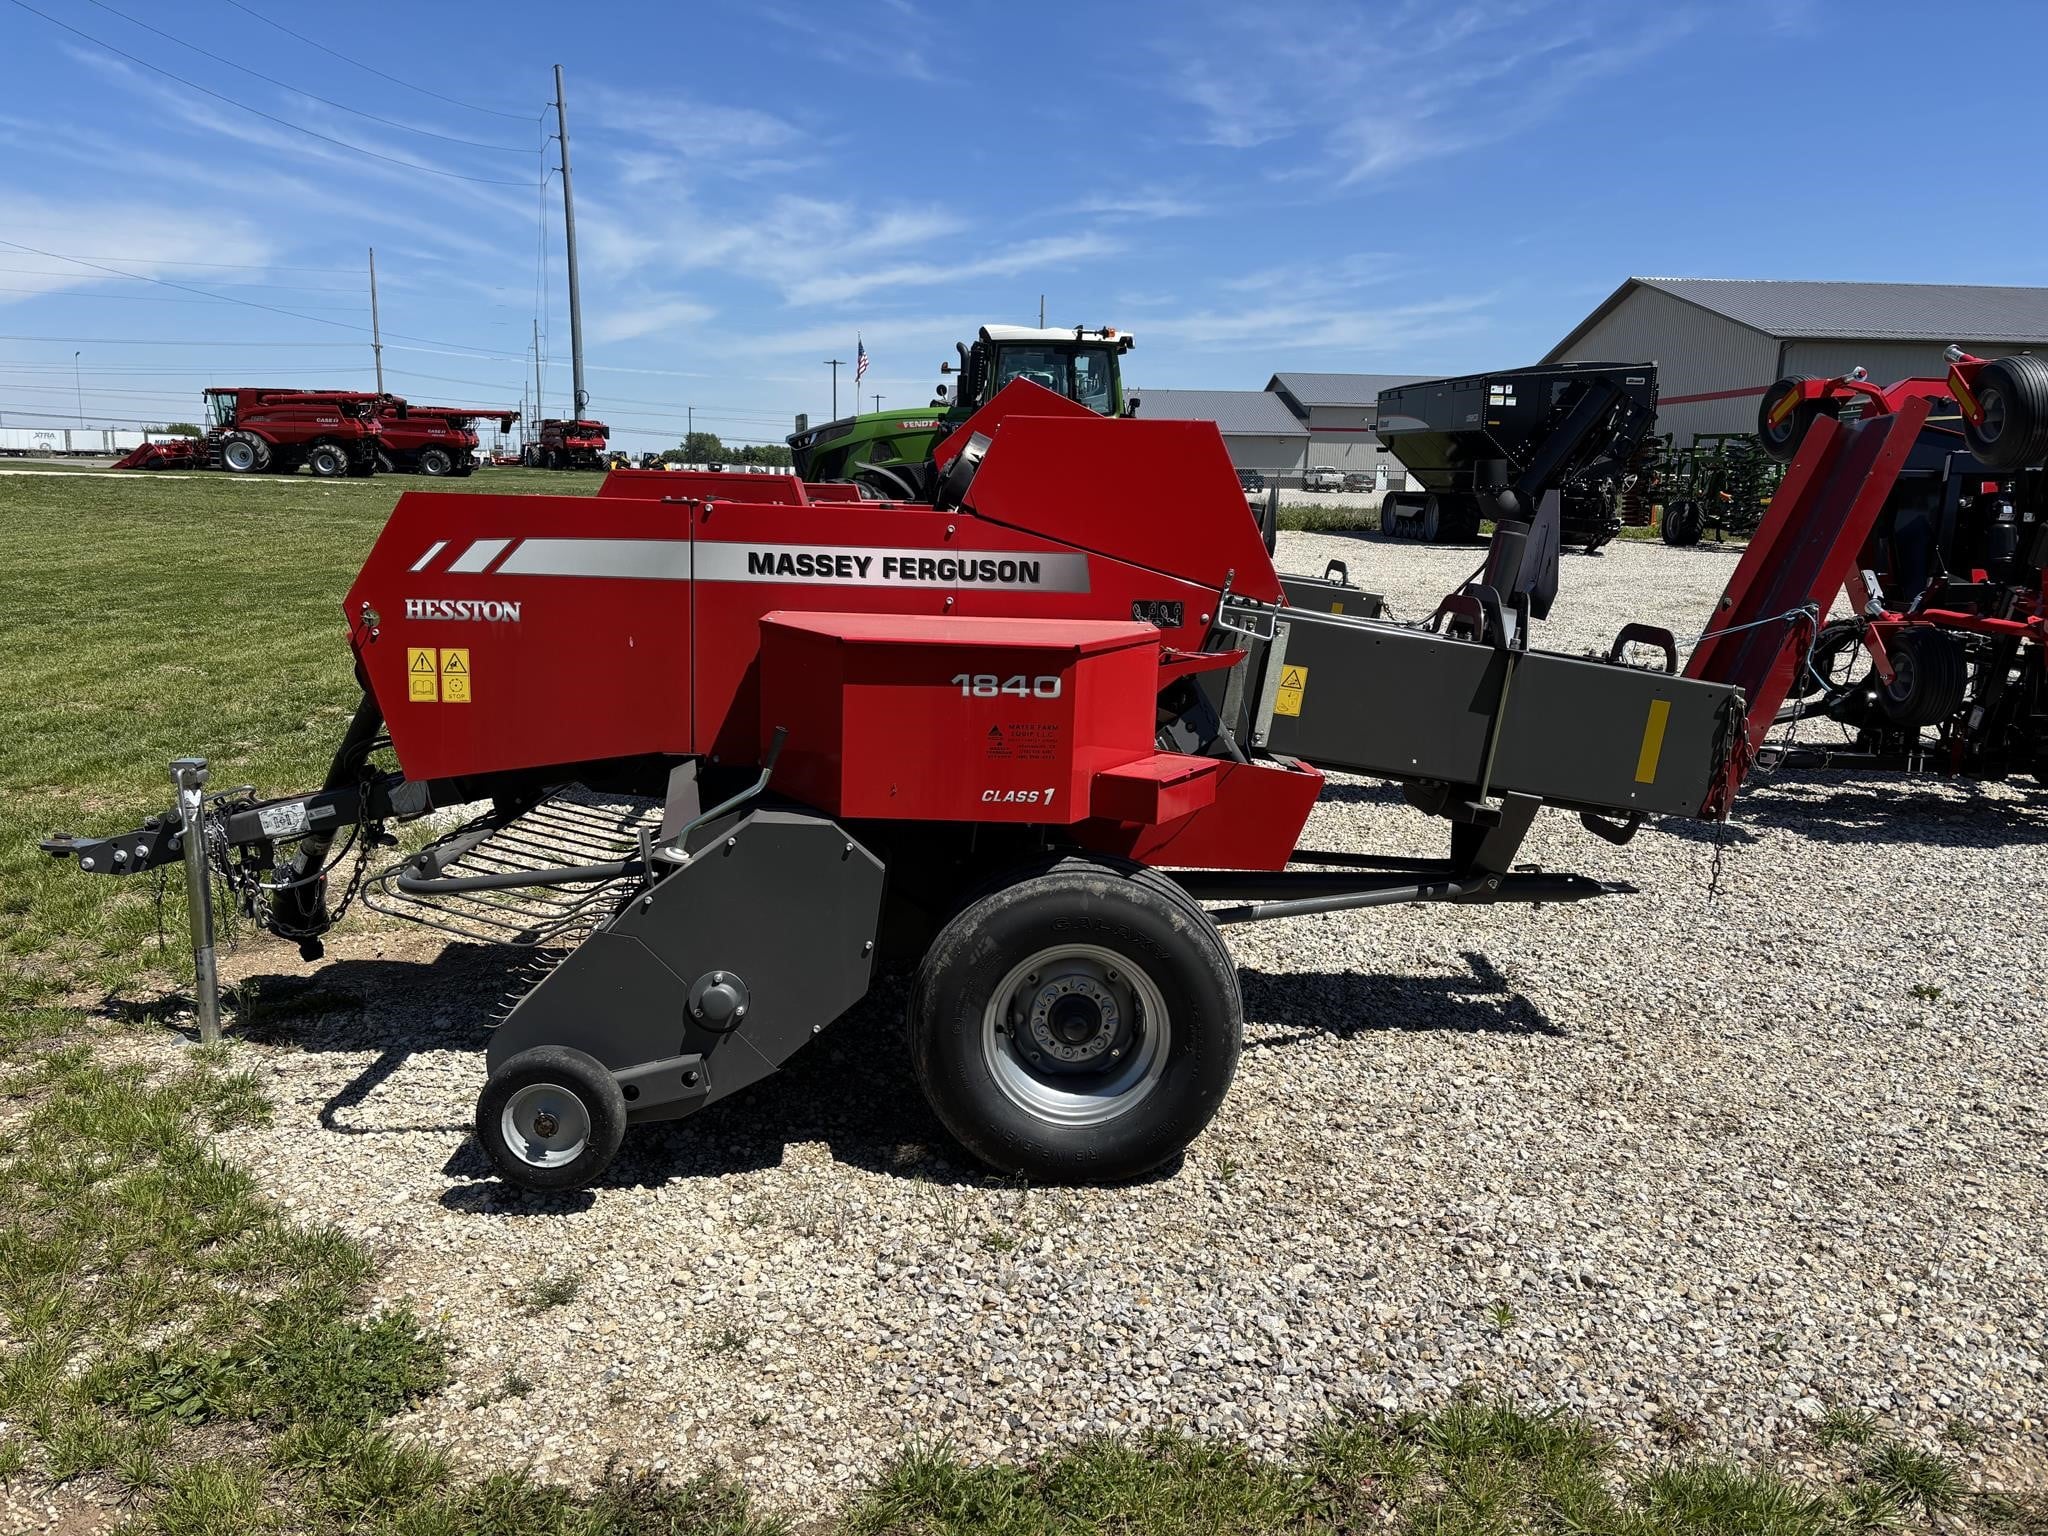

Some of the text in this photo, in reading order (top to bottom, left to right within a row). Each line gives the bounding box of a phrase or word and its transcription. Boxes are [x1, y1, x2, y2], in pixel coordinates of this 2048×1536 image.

[902, 420, 935, 428] FENDT
[33, 432, 56, 440] XTRA
[748, 551, 1041, 584] MASSEY FERGUSON
[405, 598, 521, 622] HESSTON
[951, 673, 1062, 699] 1840
[981, 787, 1056, 806] CLASS 1
